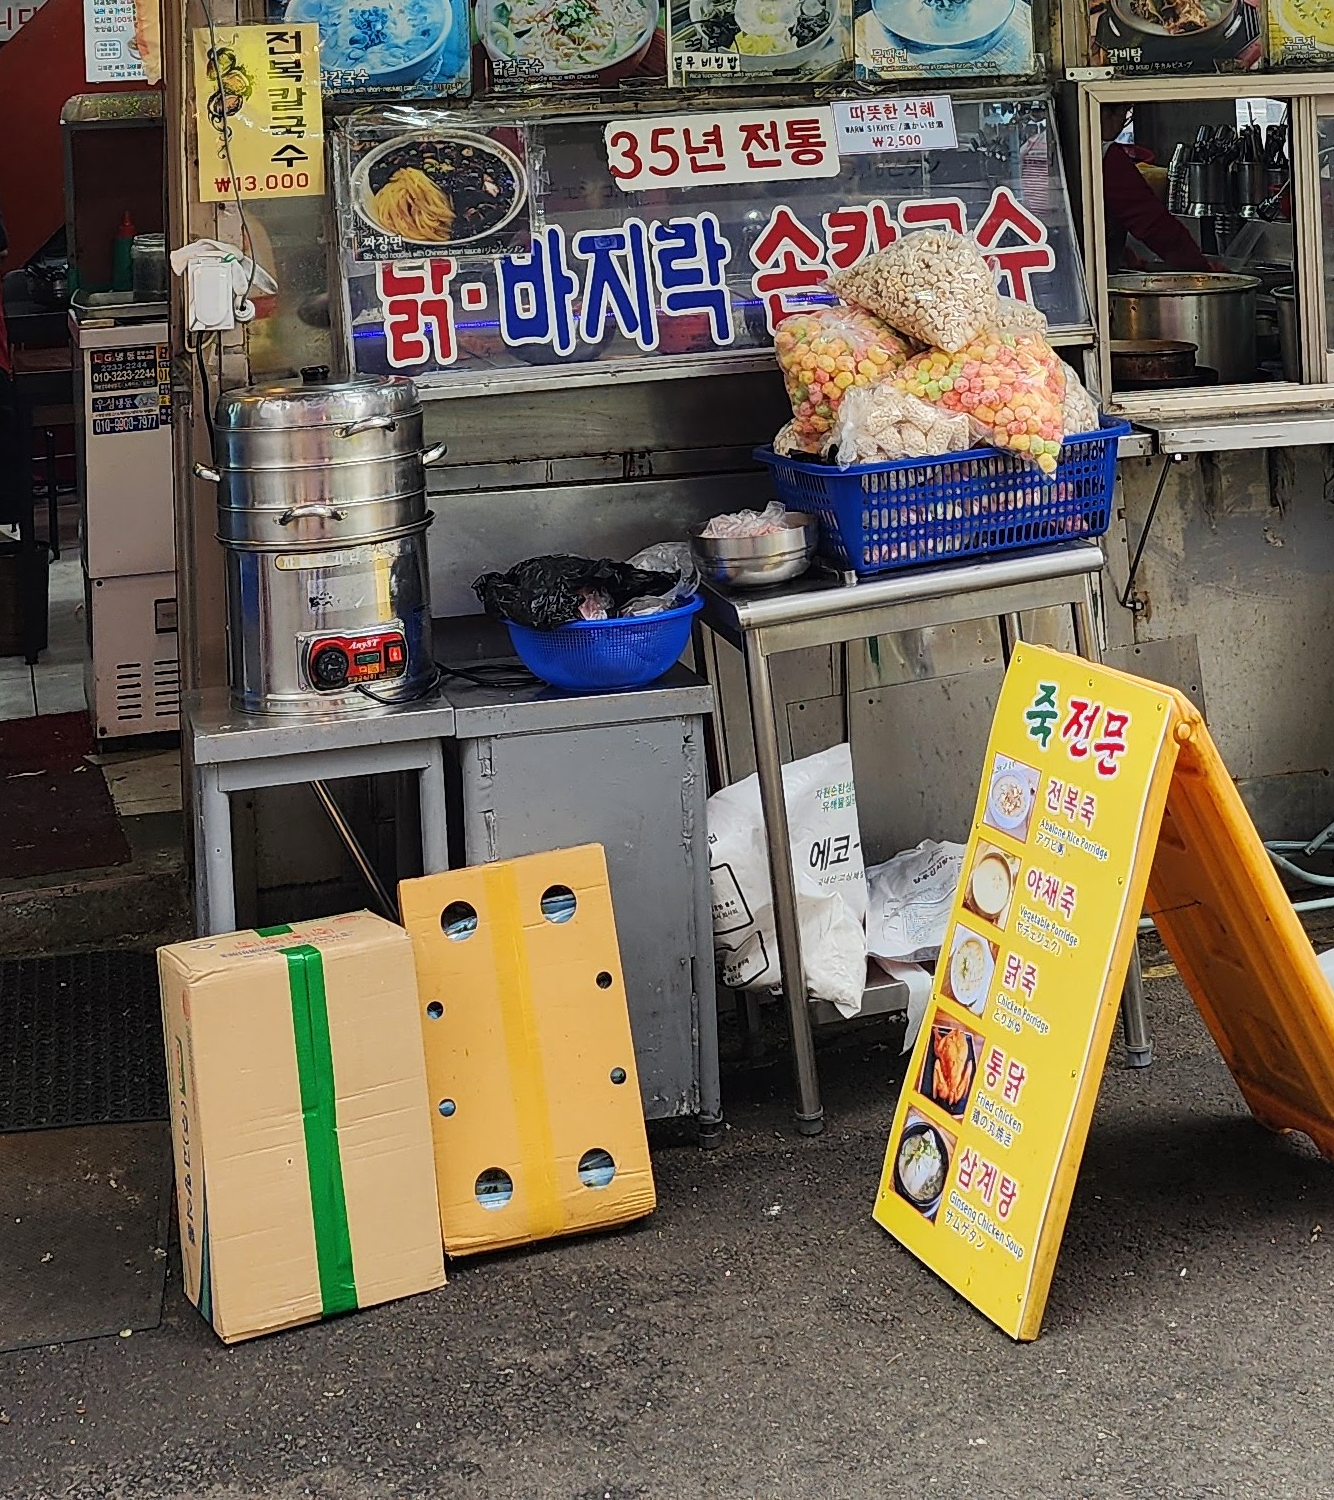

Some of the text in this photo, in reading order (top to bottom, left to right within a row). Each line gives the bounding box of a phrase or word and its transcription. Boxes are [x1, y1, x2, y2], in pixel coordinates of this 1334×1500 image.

[1107, 48, 1142, 63] 갈비탕
[850, 101, 935, 122] 따뜻한 식혜
[609, 120, 827, 180] 35년 전통
[362, 236, 402, 250] 짜장면
[506, 216, 727, 350] 바지락
[93, 369, 155, 382] 010-3233-2244
[1048, 780, 1095, 827] 전복죽
[1040, 819, 1108, 859] Abalone Rice Porridge
[1027, 870, 1075, 918] 야채죽
[1020, 906, 1078, 945] Vegetable Porridge
[1005, 955, 1036, 998] 닭죽
[998, 994, 1048, 1033] Chicken Porridge
[987, 1049, 1025, 1103] 통닭
[976, 1093, 1021, 1132] Fried chicken
[959, 1148, 1016, 1217] 삼계탕
[947, 1211, 983, 1248] サムゲタン
[950, 1192, 1023, 1259] Ginseng Chicken Soup
